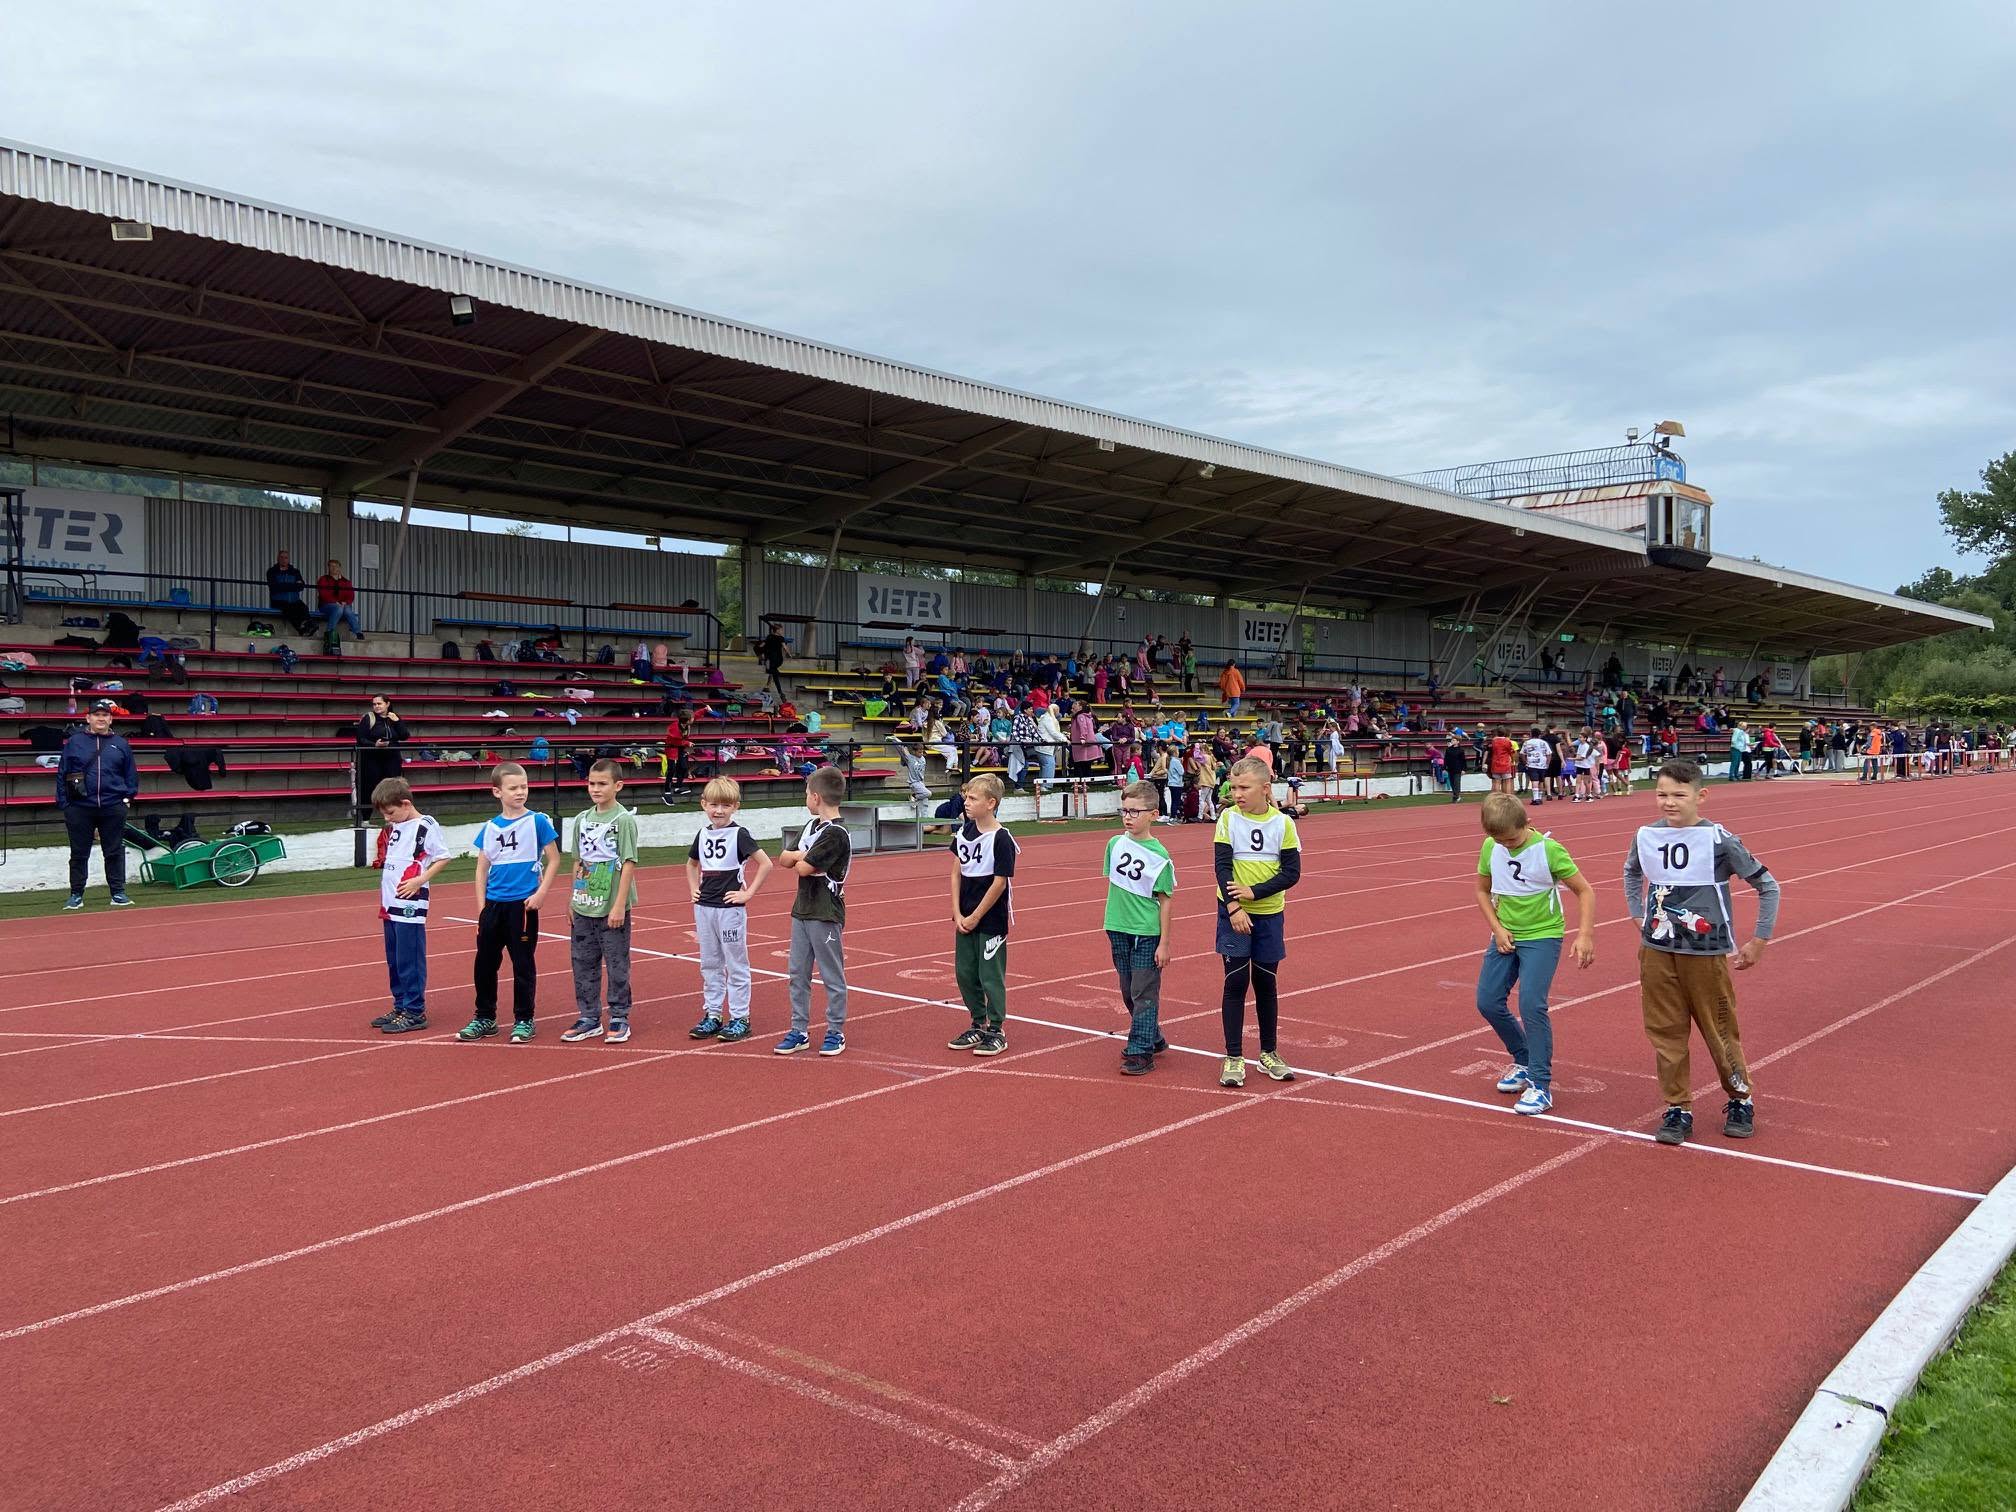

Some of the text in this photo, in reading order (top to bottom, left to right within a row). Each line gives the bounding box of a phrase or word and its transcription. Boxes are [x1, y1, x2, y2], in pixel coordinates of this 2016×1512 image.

[867, 586, 942, 619] RIETER
[496, 830, 519, 852] 14
[704, 838, 727, 859] 35
[1250, 828, 1264, 852] 9
[959, 842, 983, 864] 34
[1658, 842, 1689, 870] 10
[1116, 852, 1146, 881] 23
[1507, 860, 1526, 883] 2
[722, 929, 738, 938] NEW
